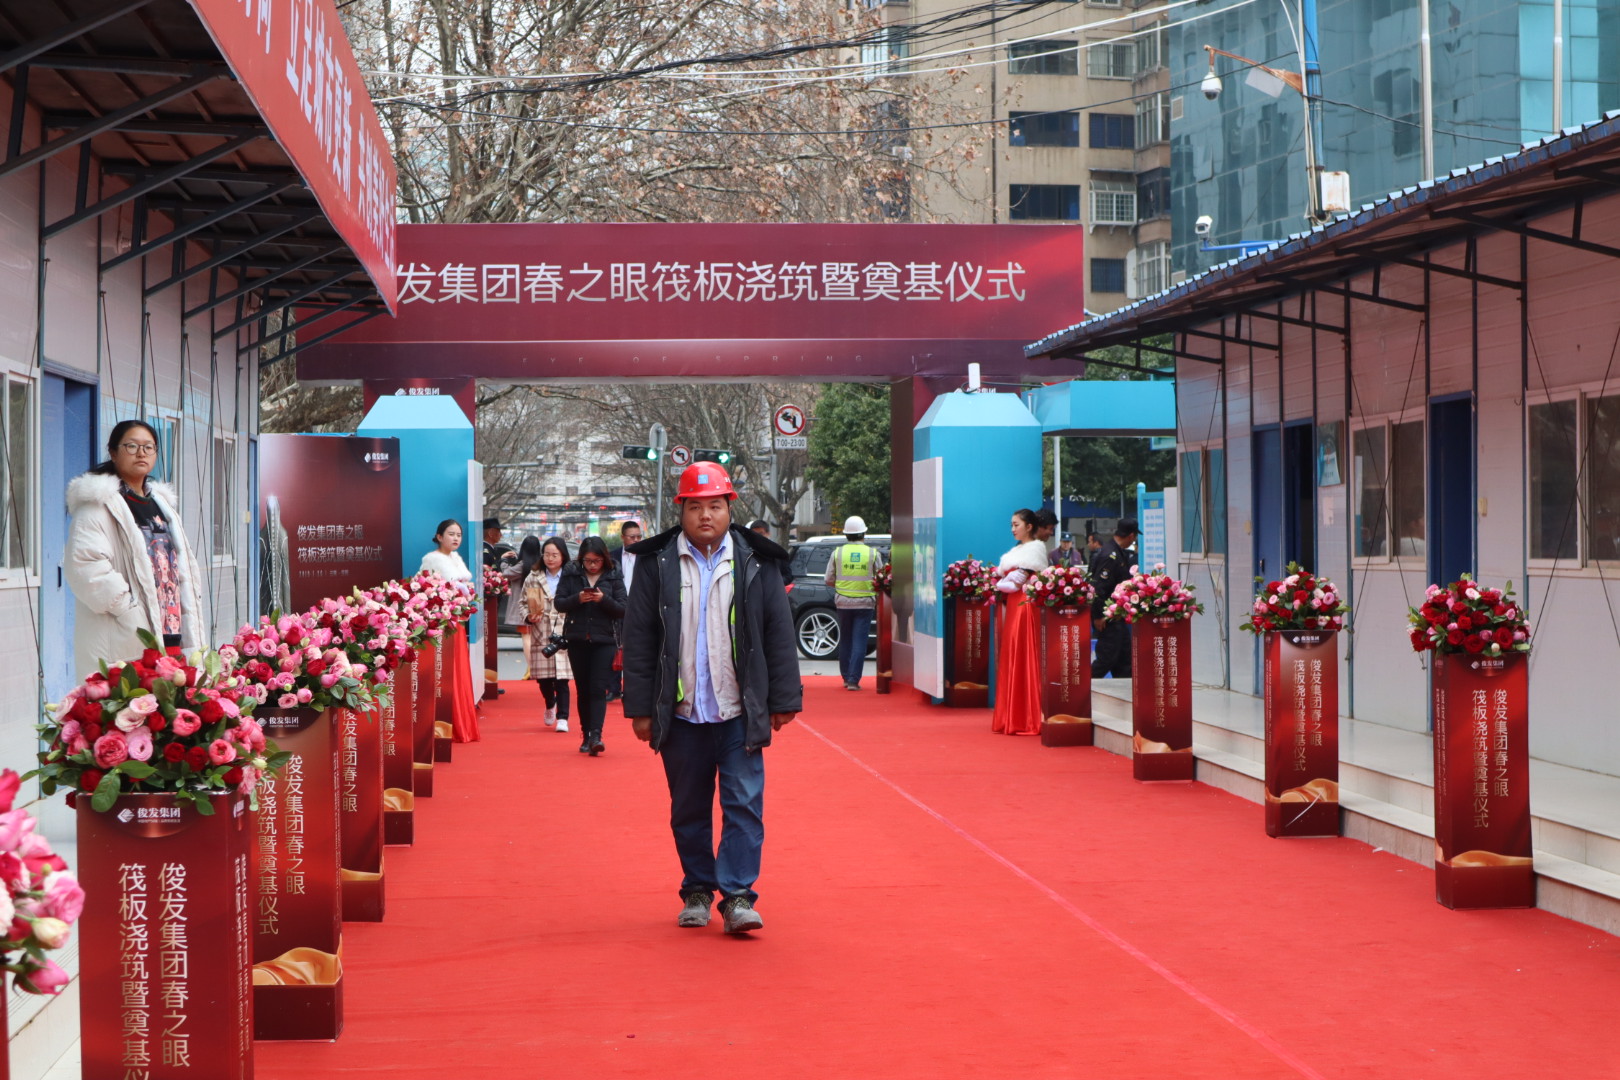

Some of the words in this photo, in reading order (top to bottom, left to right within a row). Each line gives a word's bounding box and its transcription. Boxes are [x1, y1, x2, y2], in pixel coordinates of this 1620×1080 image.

[396, 261, 1026, 304] 发集团春之眼筏板浇筑暨奠基仪式
[1472, 689, 1489, 829] 筏板浇筑暨奠基仪式
[1493, 688, 1509, 797] 俊发集团春之眼
[137, 807, 181, 818] 俊发集团
[157, 862, 191, 1068] 俊发集团春之眼
